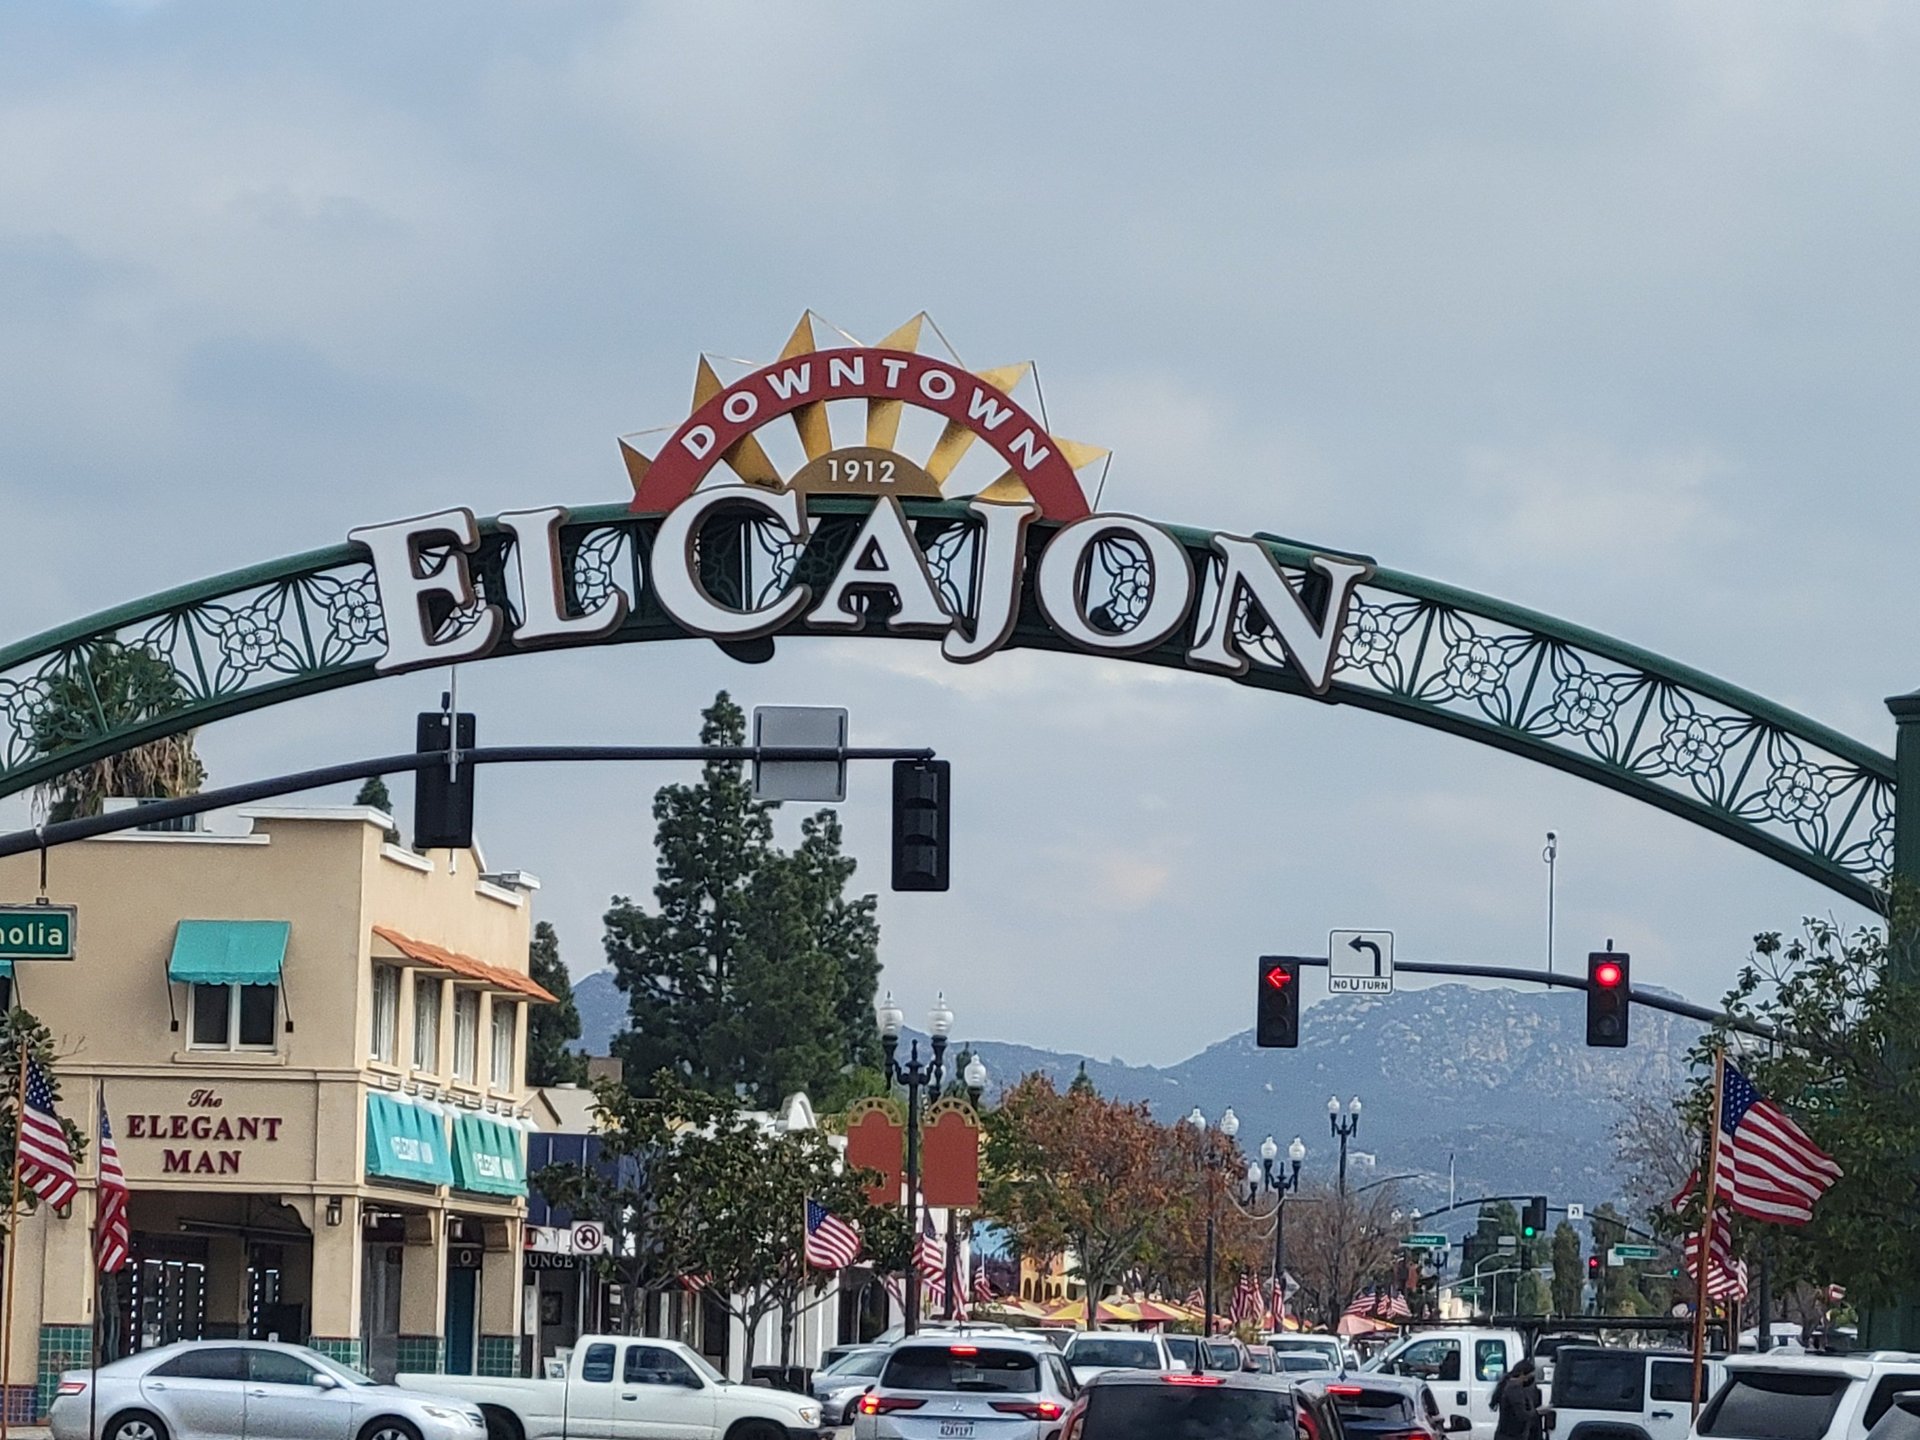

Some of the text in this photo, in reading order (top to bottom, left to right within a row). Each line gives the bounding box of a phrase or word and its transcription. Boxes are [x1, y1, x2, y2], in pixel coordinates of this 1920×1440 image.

[680, 355, 1051, 471] DOWNTOWN
[827, 459, 896, 484] 1912
[348, 485, 1370, 691] EL CAJON
[1333, 979, 1388, 990] NO U TURN
[187, 1089, 223, 1108] The
[126, 1115, 283, 1141] ELEGANT
[162, 1149, 242, 1174] MAN
